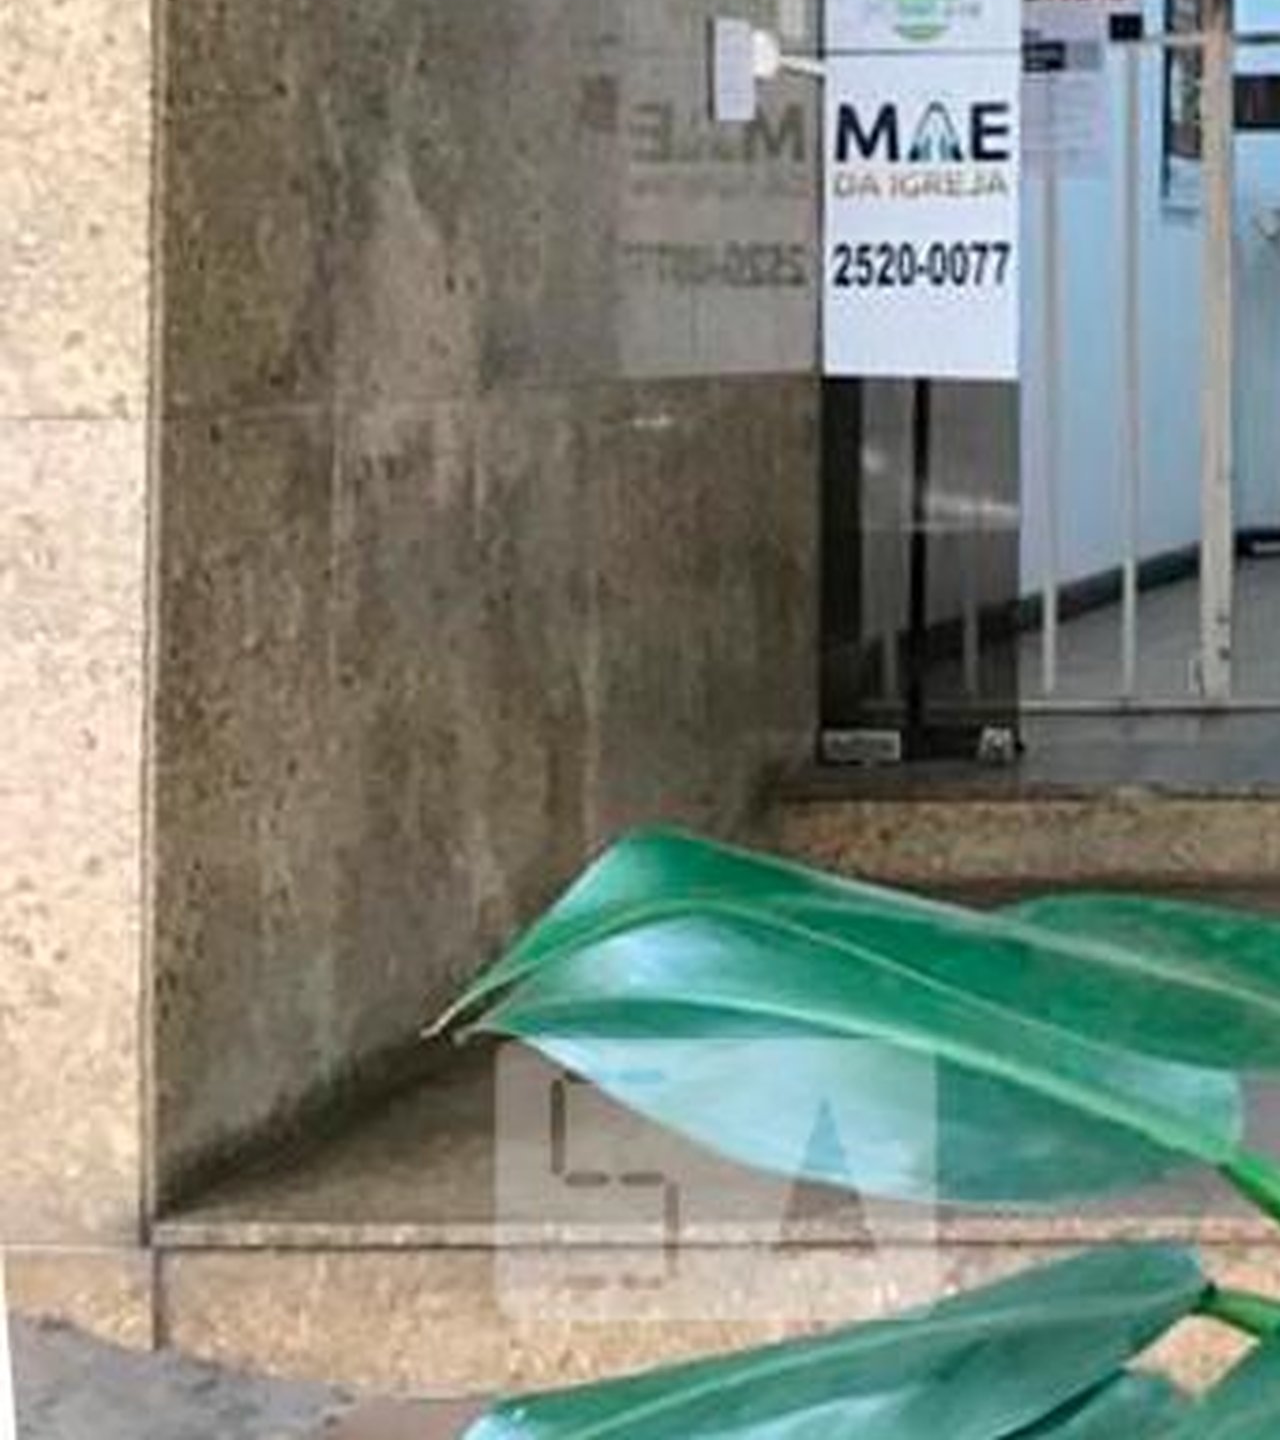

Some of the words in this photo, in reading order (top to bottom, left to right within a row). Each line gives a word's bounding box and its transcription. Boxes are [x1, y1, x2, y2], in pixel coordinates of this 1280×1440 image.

[835, 172, 881, 197] DA
[888, 170, 1009, 197] IGREJA
[833, 242, 1011, 288] 2520-0077
